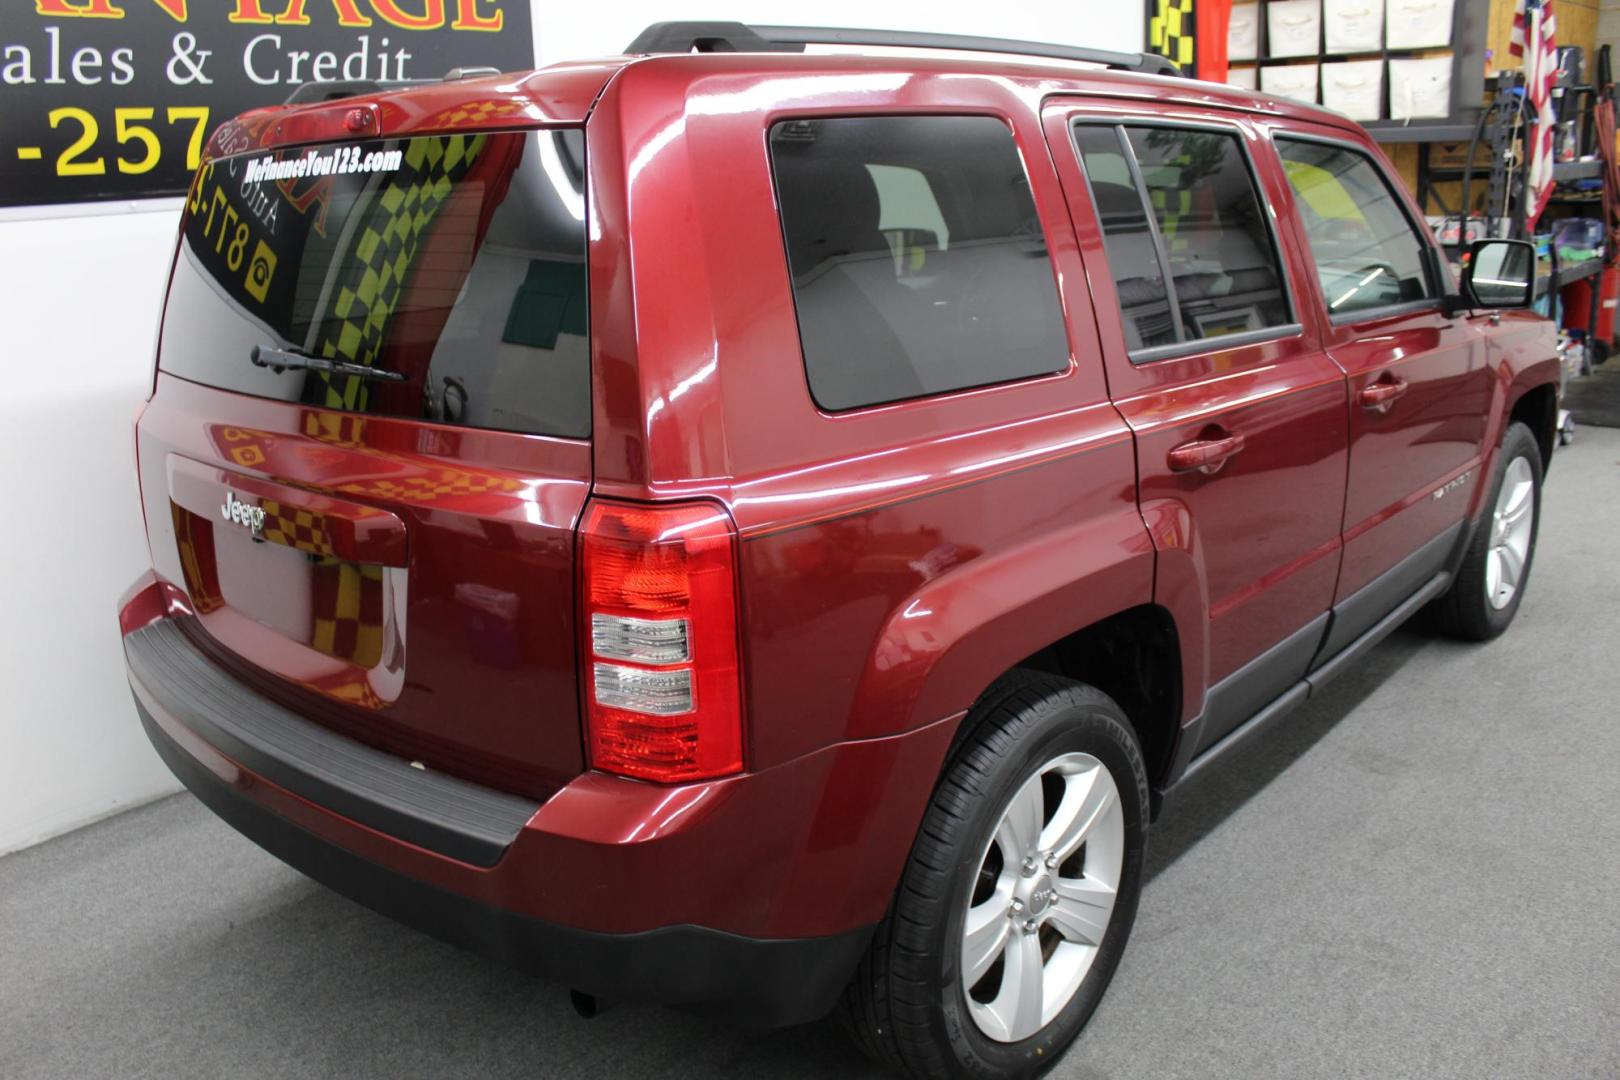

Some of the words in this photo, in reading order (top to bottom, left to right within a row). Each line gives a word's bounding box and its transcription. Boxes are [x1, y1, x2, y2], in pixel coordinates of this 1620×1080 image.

[165, 31, 214, 86] &
[243, 34, 412, 84] Credit
[245, 146, 402, 184] WeFinanceYou123.com
[221, 491, 265, 535] Jeep
